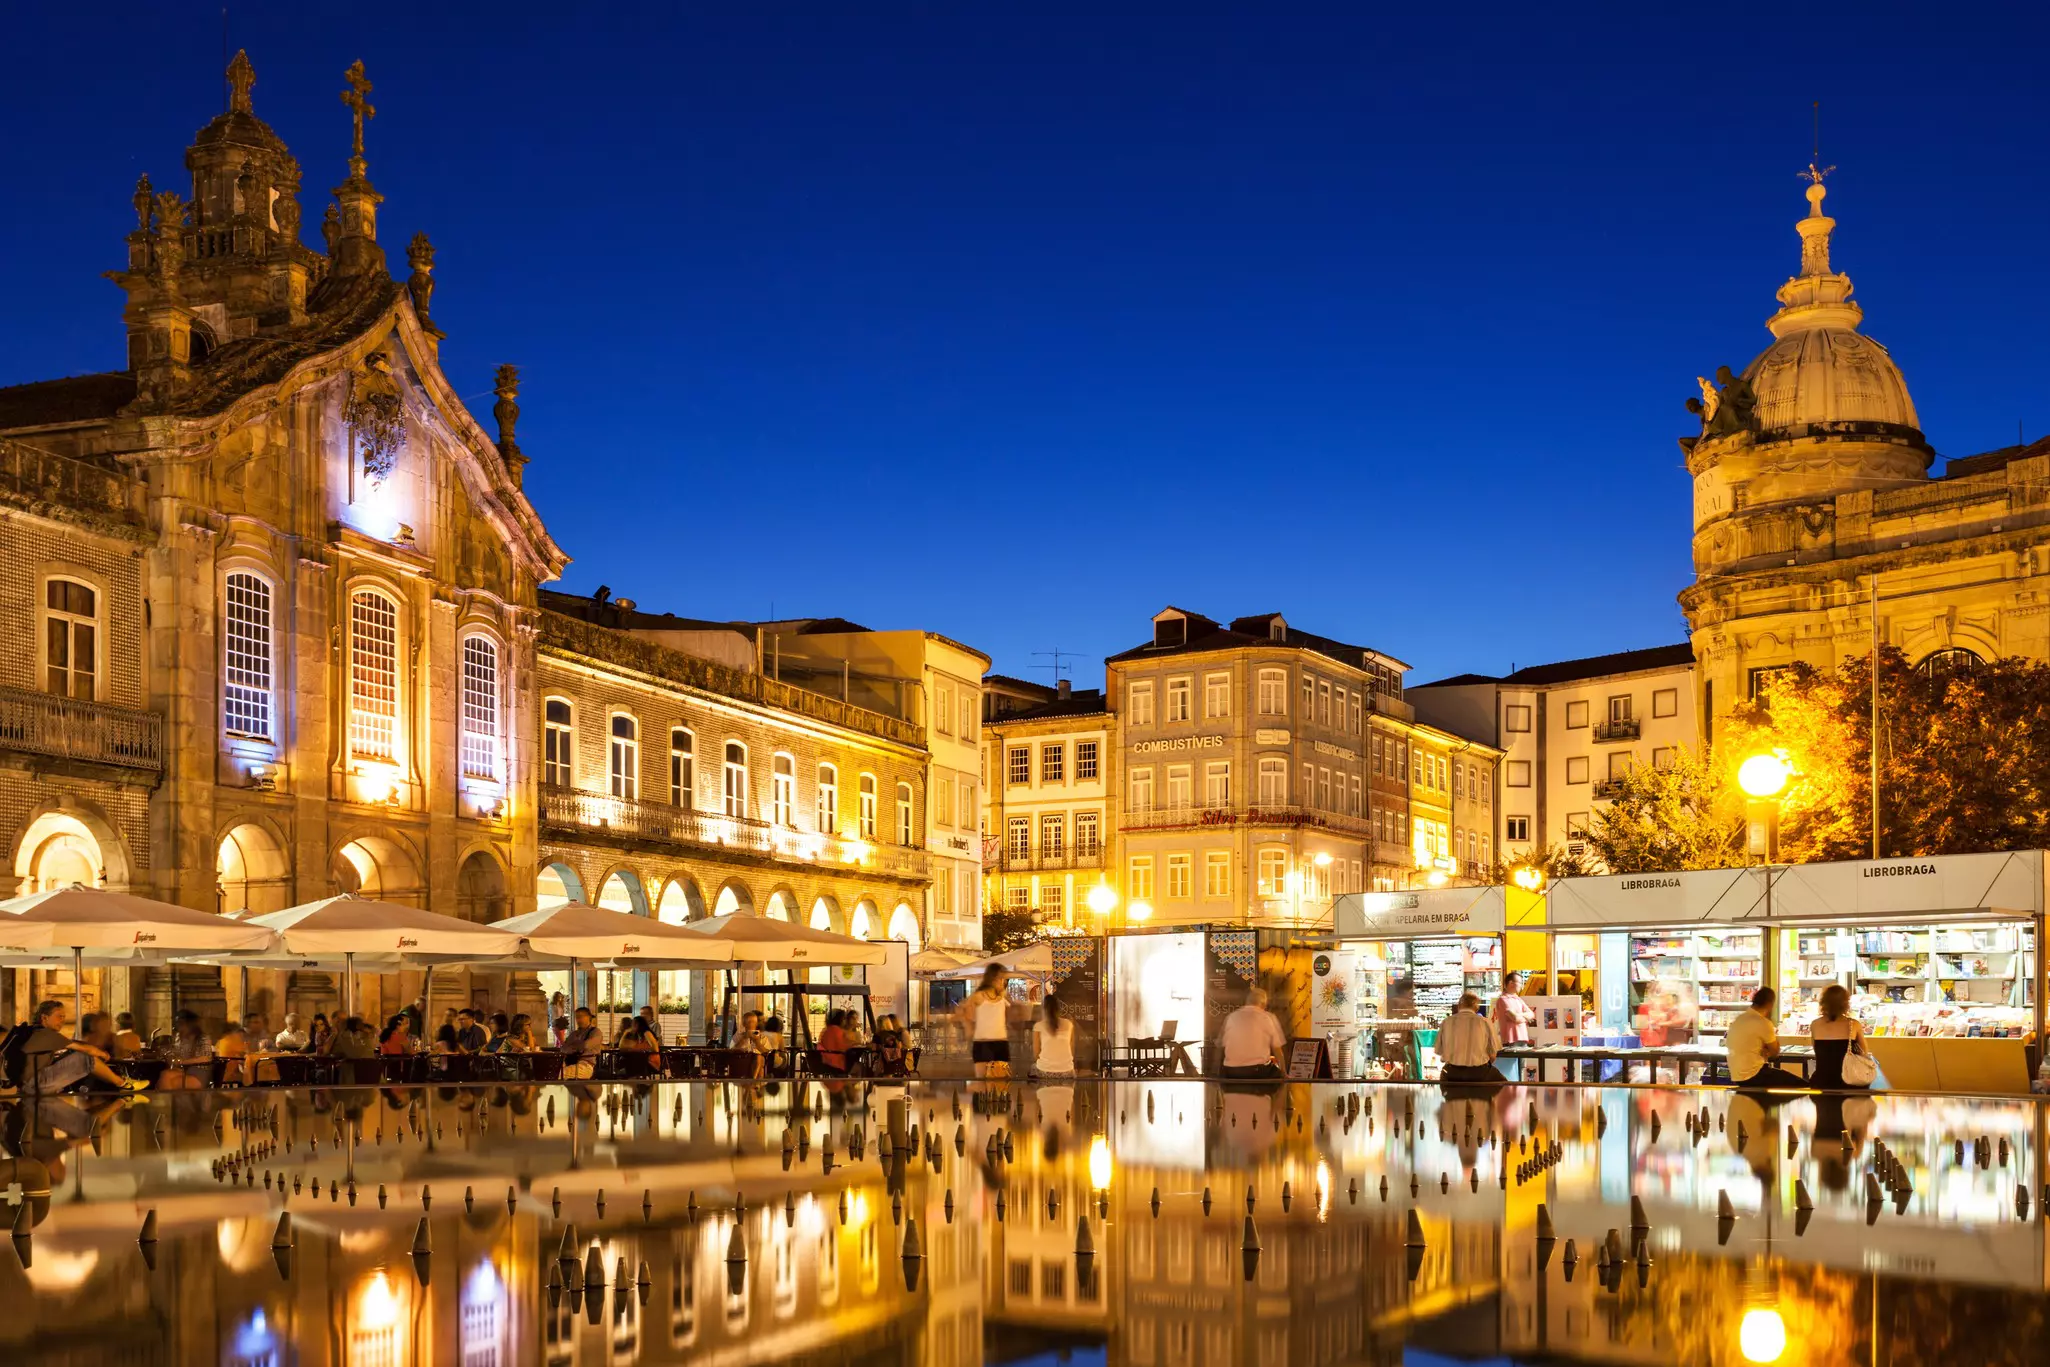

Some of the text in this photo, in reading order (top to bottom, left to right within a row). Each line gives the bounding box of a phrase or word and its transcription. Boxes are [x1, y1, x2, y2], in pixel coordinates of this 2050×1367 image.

[1134, 735, 1223, 753] COMBUSTÍVEIS
[1200, 810, 1237, 825] Silva
[1863, 864, 1936, 877] LIBROBRAGA
[1621, 878, 1681, 889] LIBROBRAGA
[1389, 914, 1430, 924] APELARIA
[1431, 914, 1443, 923] EM
[1444, 913, 1470, 922] BRAGA
[869, 995, 892, 1004] stgroup
